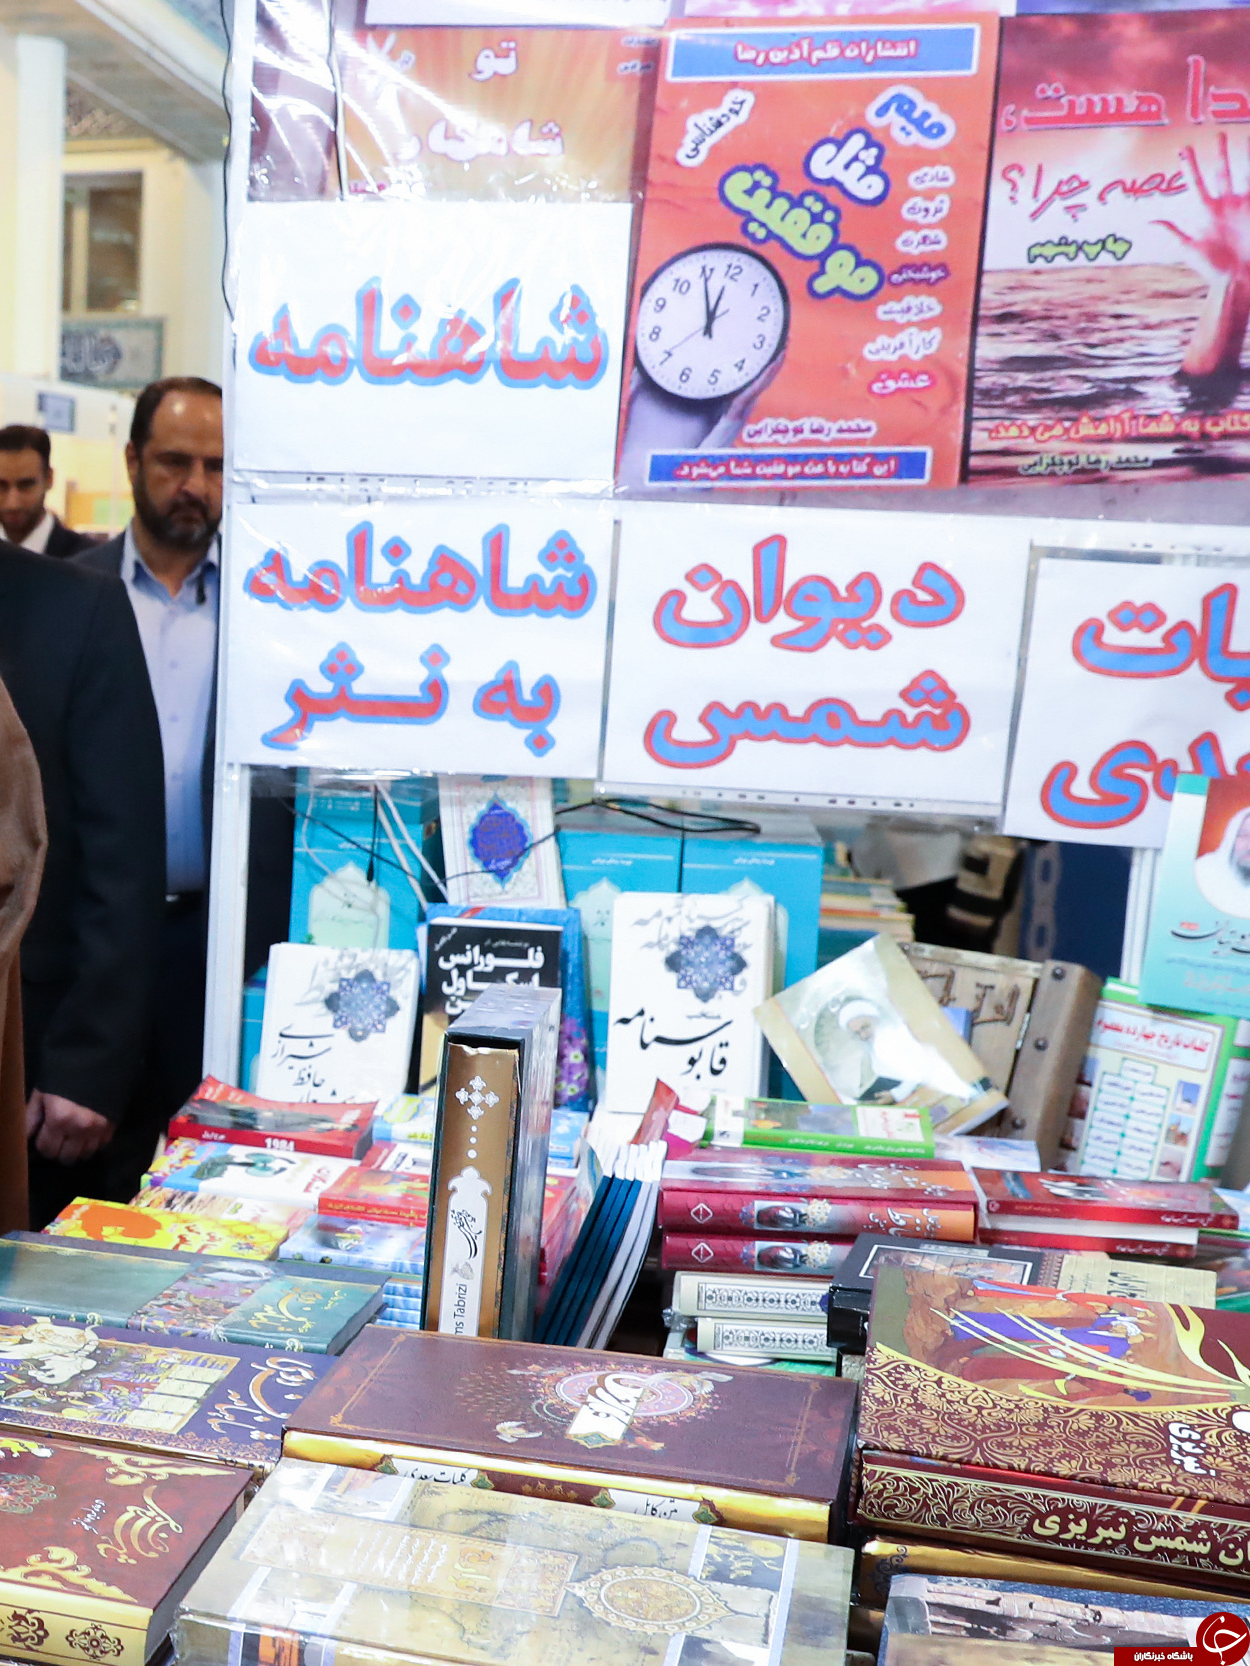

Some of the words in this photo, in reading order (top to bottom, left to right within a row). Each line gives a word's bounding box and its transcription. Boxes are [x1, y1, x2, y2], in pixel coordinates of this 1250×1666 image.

[844, 39, 918, 66] انتشارات
[1188, 54, 1250, 125] دا
[871, 90, 951, 143] میم
[807, 130, 888, 204] مثل
[721, 168, 882, 298] موفقیت
[724, 263, 744, 282] 12
[672, 277, 691, 295] 10
[751, 283, 759, 297] 1
[653, 297, 667, 313] 9
[757, 305, 771, 322] 2
[248, 275, 609, 389] شاهنامه
[649, 325, 662, 342] 8
[753, 334, 766, 350] 3
[659, 350, 673, 366] 7
[734, 358, 746, 372] 4
[679, 367, 692, 383] 6
[708, 369, 722, 386] 5
[869, 370, 934, 396] عشق
[1034, 421, 1065, 443] می
[1068, 408, 1133, 441] آرامش
[1137, 410, 1175, 434] شما
[728, 458, 753, 476] شما
[755, 459, 803, 480] موفقیت
[839, 456, 871, 477] کتاب
[871, 457, 897, 478] این
[244, 519, 597, 619] شاهنامه
[653, 533, 965, 653] دیوان
[261, 641, 450, 751] نثر
[473, 659, 561, 758] به
[643, 669, 971, 770] شمس
[265, 1136, 296, 1151] 1984
[453, 1283, 467, 1319] Tabrizi
[1168, 1422, 1216, 1477] تبریزی
[1032, 1514, 1129, 1546] تبریزی
[1133, 1529, 1212, 1555] شمس
